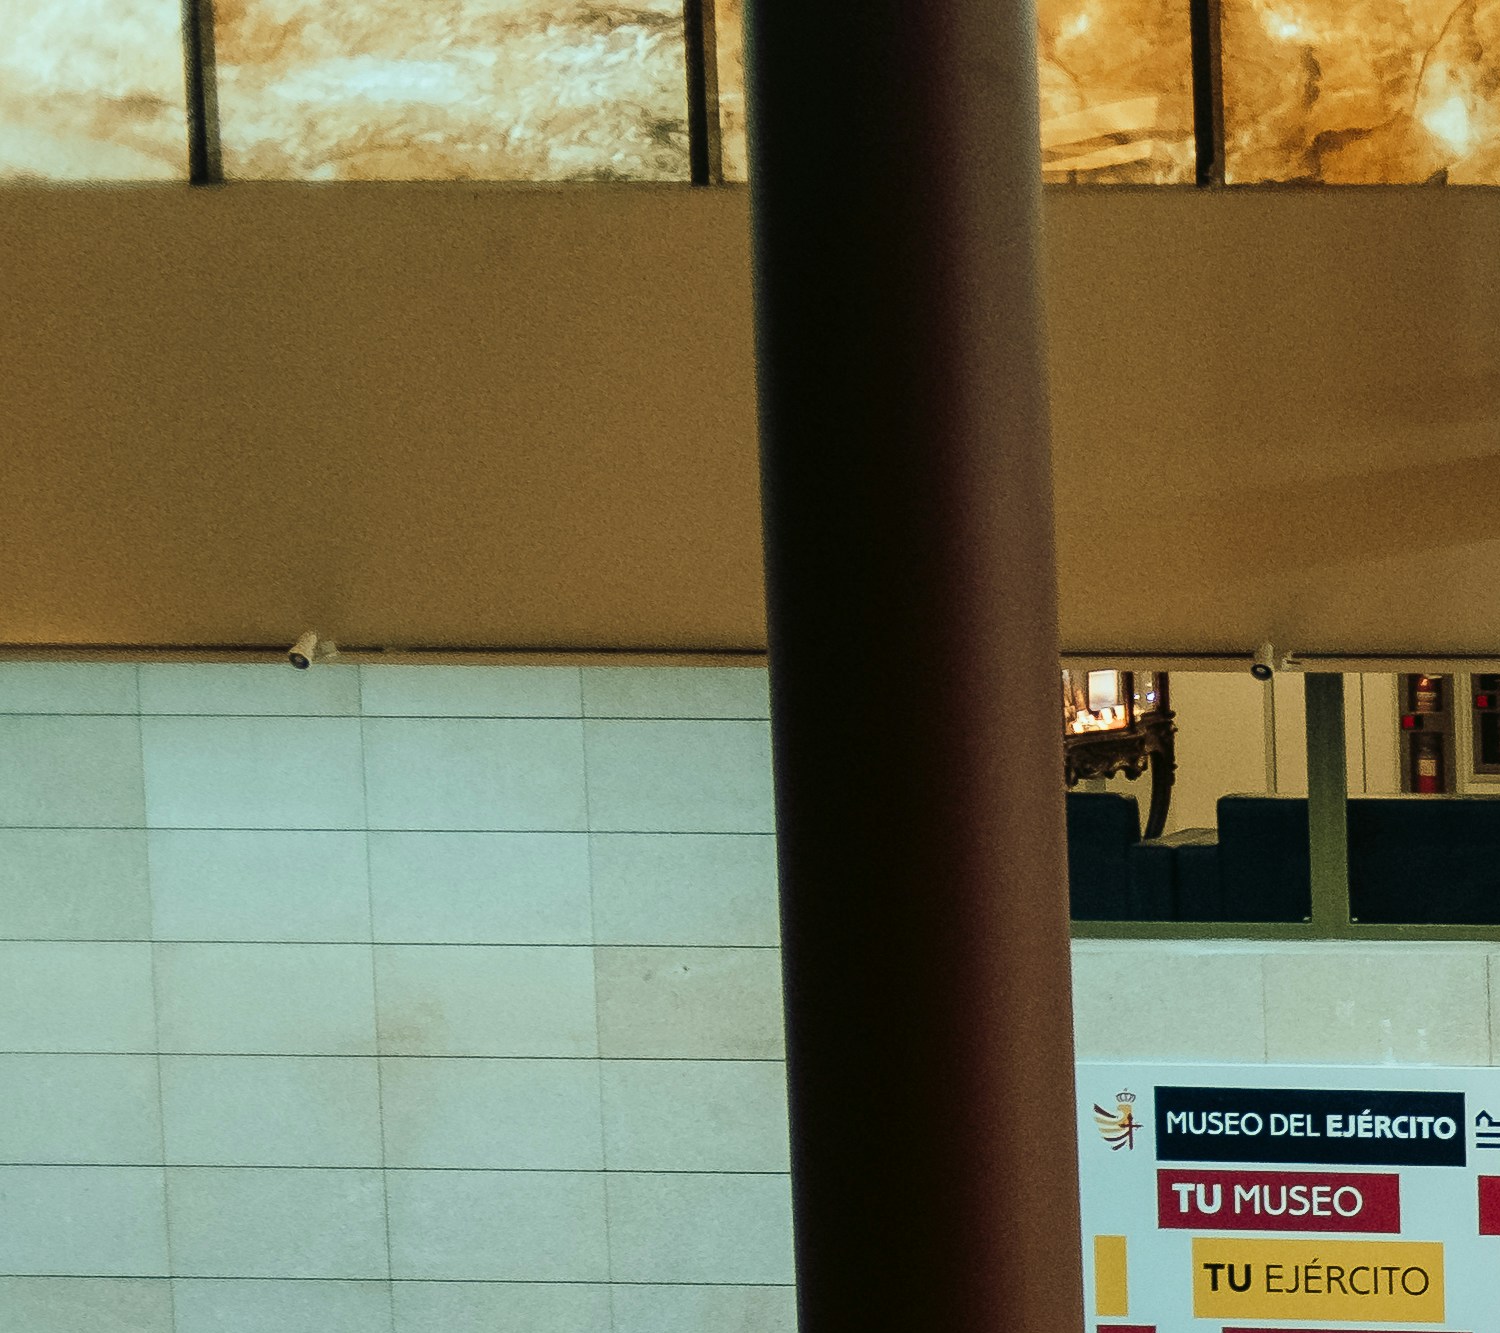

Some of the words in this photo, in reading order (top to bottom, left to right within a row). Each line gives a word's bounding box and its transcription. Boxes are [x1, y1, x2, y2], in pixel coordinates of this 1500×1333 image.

[1166, 1111, 1263, 1136] MUSEO
[1271, 1114, 1322, 1137] DEL
[1327, 1110, 1457, 1140] EJÉRCITO
[1172, 1183, 1222, 1213] TU
[1234, 1185, 1363, 1217] MUSEO
[1203, 1263, 1252, 1291] TU
[1265, 1258, 1429, 1296] EJÉRCITO
